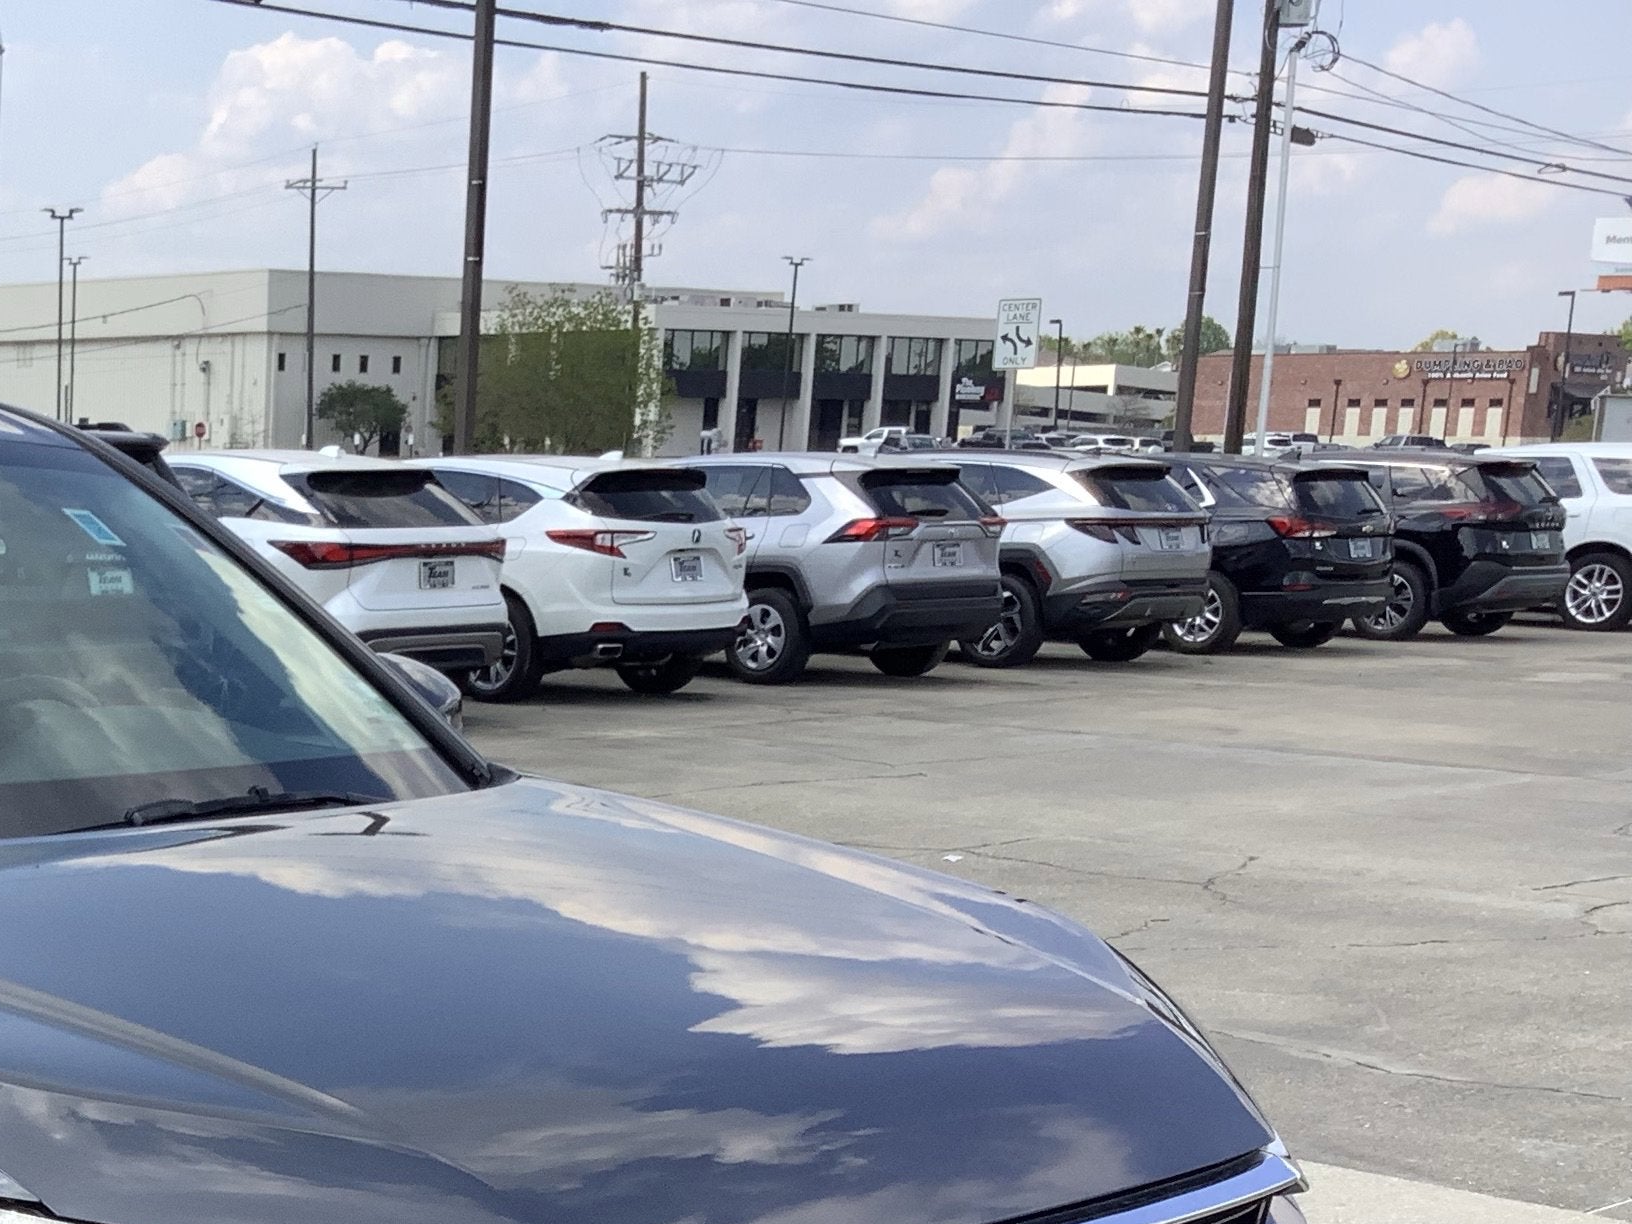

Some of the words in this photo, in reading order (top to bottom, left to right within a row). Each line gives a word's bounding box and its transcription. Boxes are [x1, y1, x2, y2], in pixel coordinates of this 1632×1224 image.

[1002, 302, 1038, 312] CENTER
[1006, 312, 1032, 321] LANE
[1002, 356, 1027, 366] ONLY
[428, 566, 449, 579] TEAM
